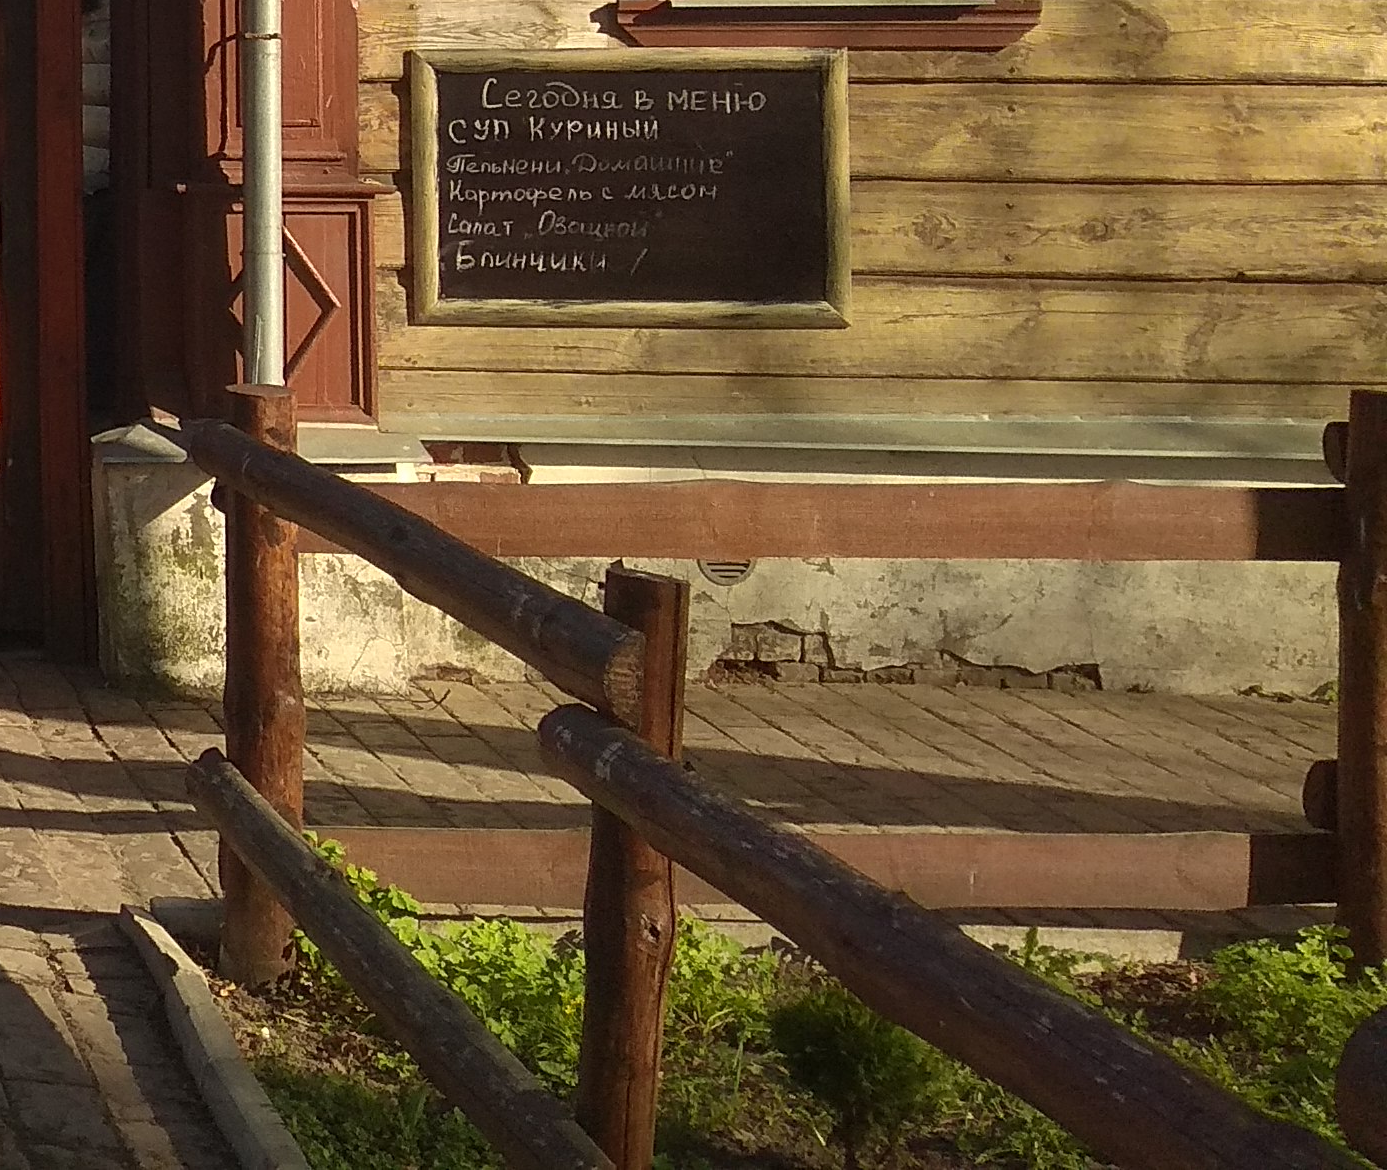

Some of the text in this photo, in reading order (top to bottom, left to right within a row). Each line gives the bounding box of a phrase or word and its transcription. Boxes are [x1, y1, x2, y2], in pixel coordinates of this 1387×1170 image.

[481, 78, 623, 111] Сегодня
[449, 180, 594, 215] Картофель
[447, 213, 515, 238] Салат
